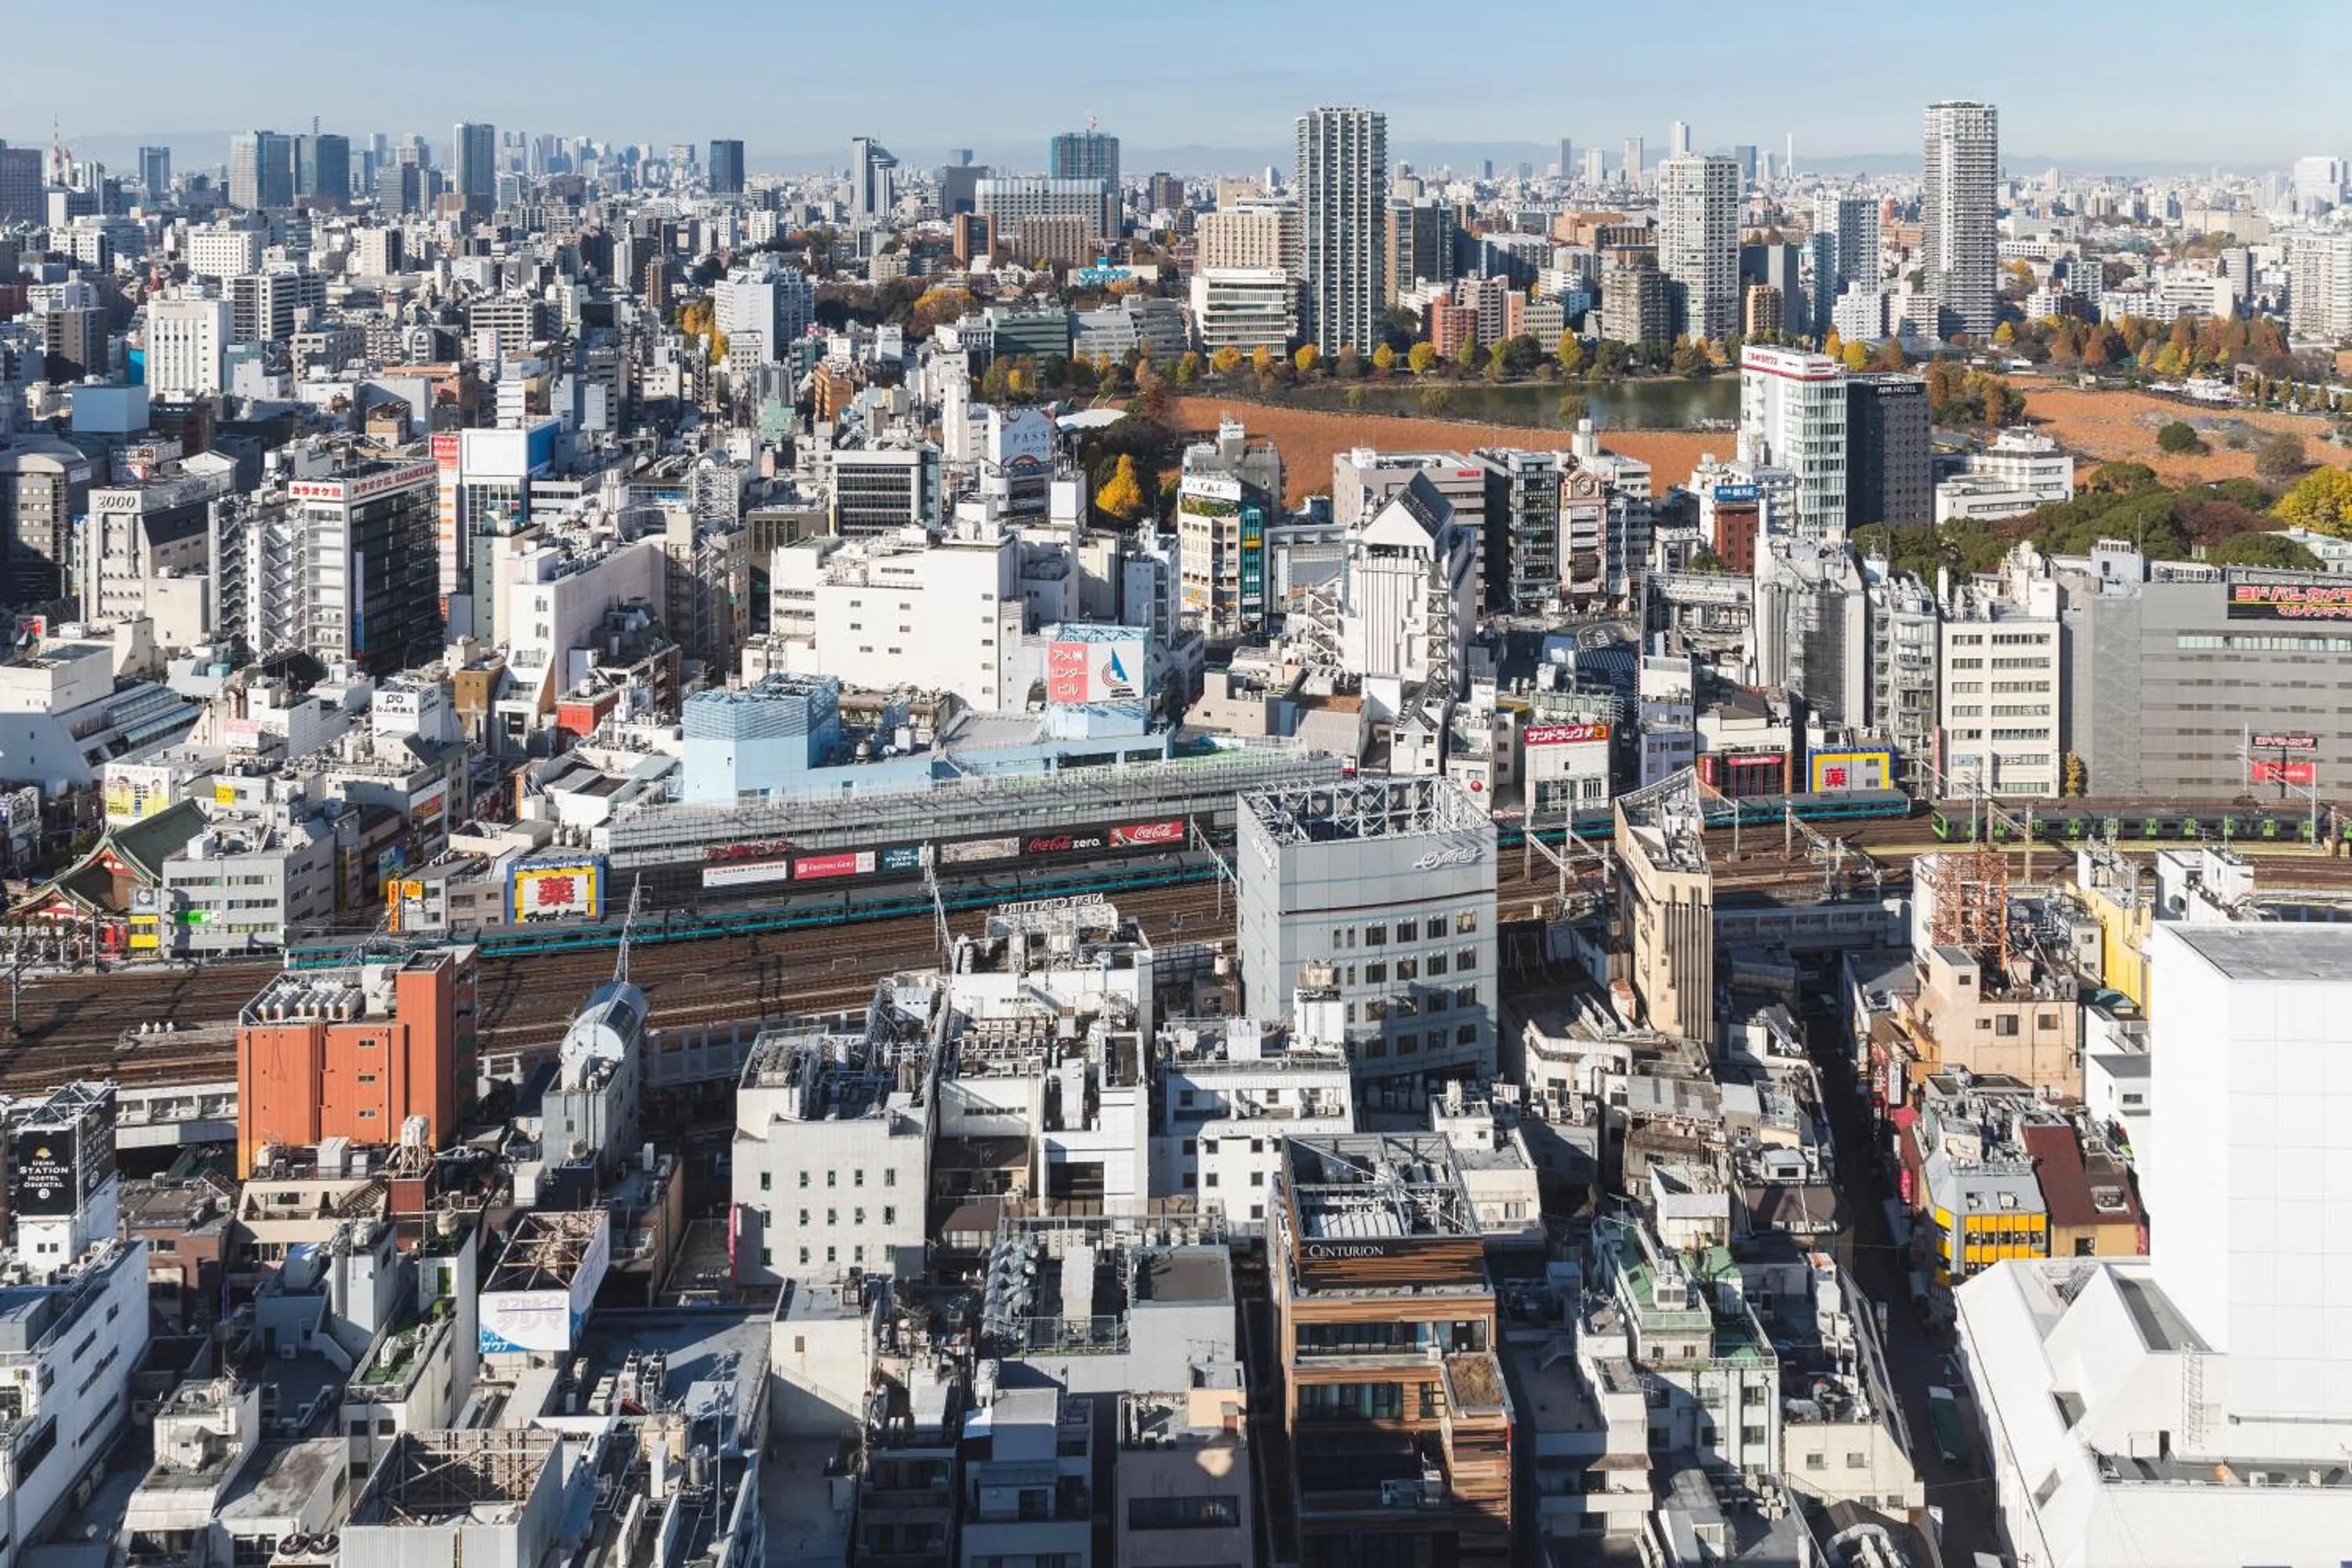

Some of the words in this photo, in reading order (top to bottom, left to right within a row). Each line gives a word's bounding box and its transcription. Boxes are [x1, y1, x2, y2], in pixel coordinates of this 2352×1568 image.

[1058, 684, 1079, 695] ビル
[1528, 728, 1583, 742] サンドラッグ
[1134, 823, 1174, 839] Coca-Cola
[1029, 835, 1073, 852] Coca-Cola
[20, 1166, 68, 1174] STATION
[1308, 1244, 1384, 1257] CENTURION
